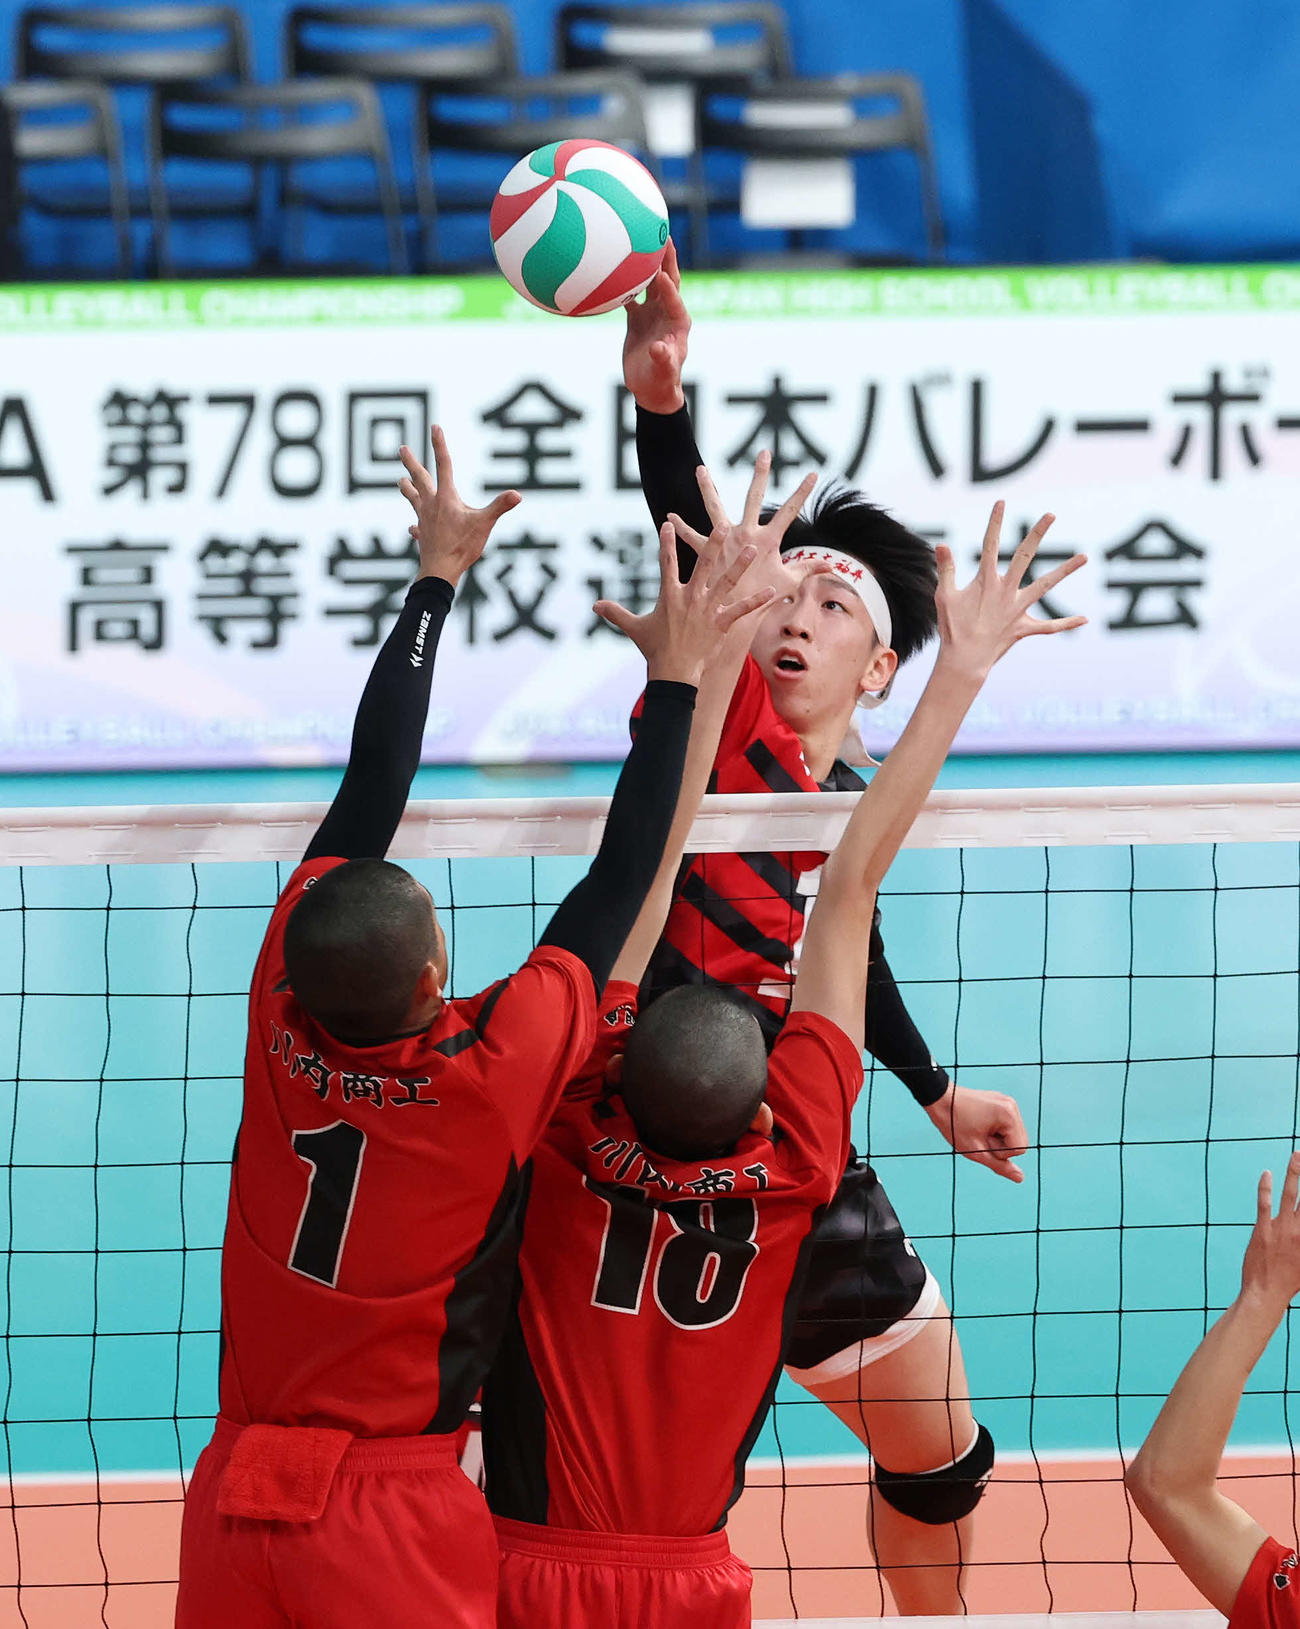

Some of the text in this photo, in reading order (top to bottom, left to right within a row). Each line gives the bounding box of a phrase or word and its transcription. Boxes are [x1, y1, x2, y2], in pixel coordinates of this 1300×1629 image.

[1023, 272, 1249, 313] VOLLEYBALL
[102, 387, 430, 501] 第78回
[269, 1020, 441, 1109] 川内商工
[287, 1119, 368, 1288] 1
[581, 1174, 761, 1331] 18
